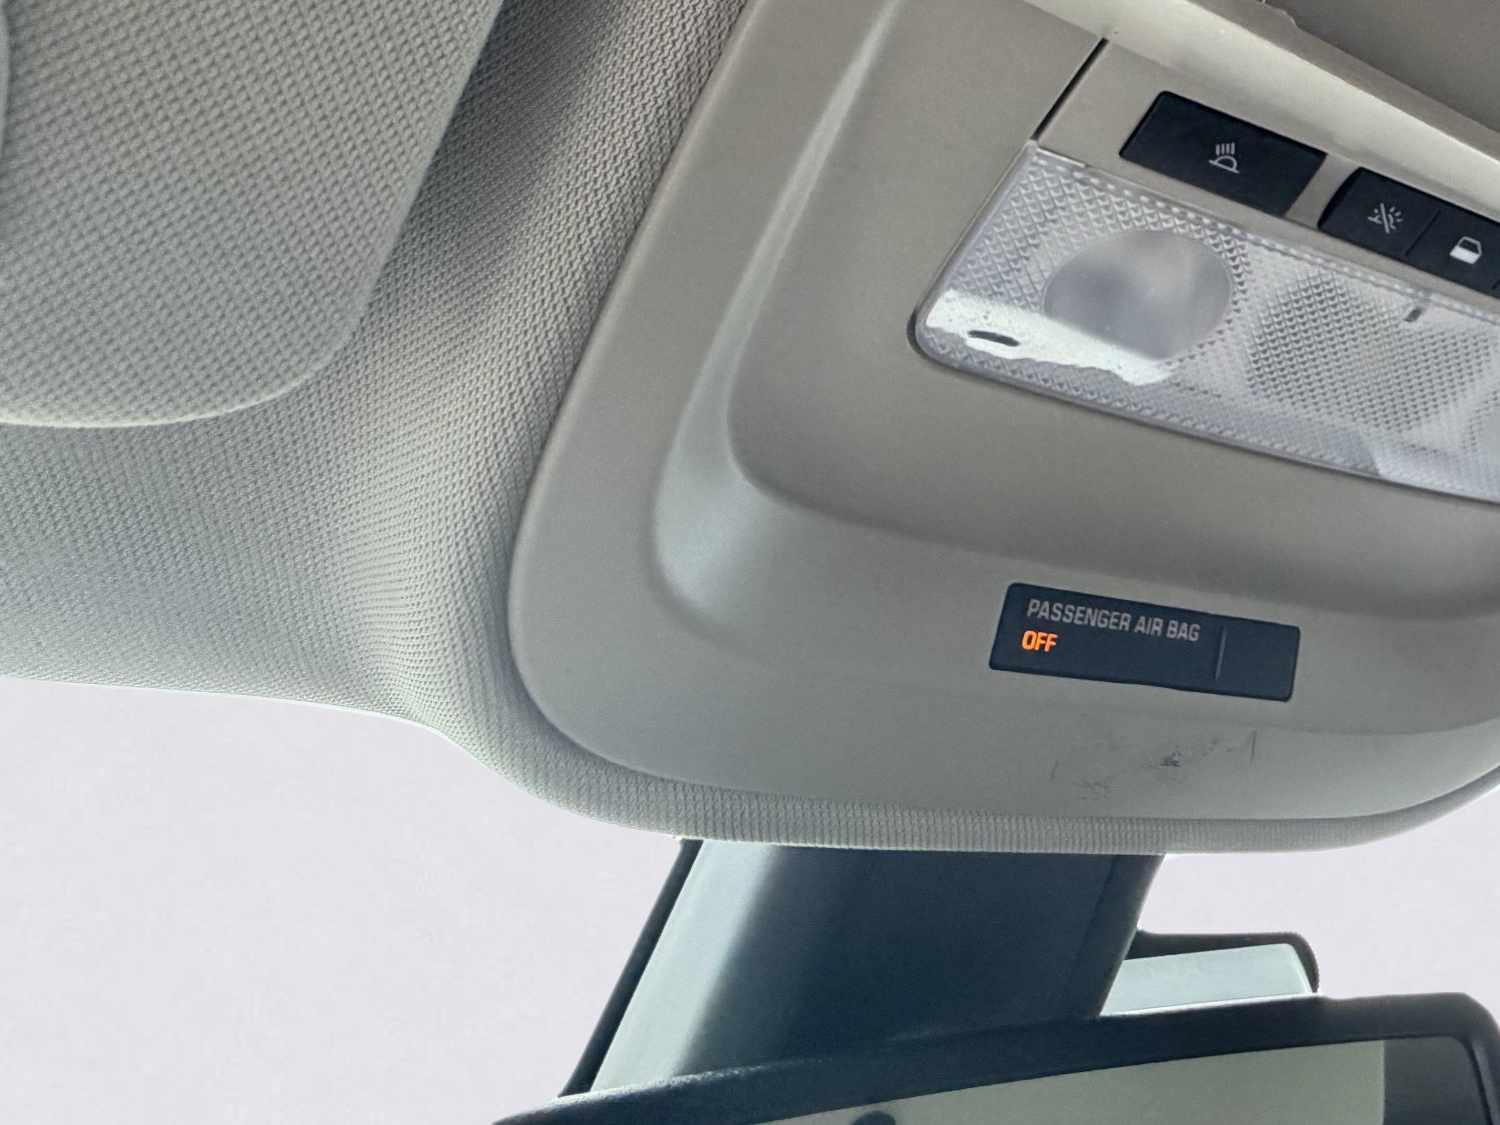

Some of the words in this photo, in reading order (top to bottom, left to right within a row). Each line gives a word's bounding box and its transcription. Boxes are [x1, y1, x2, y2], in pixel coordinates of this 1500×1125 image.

[1027, 598, 1129, 632] PASSENGER
[1133, 615, 1162, 637] AIR
[1166, 620, 1201, 642] BAG
[1021, 630, 1058, 652] OFF
